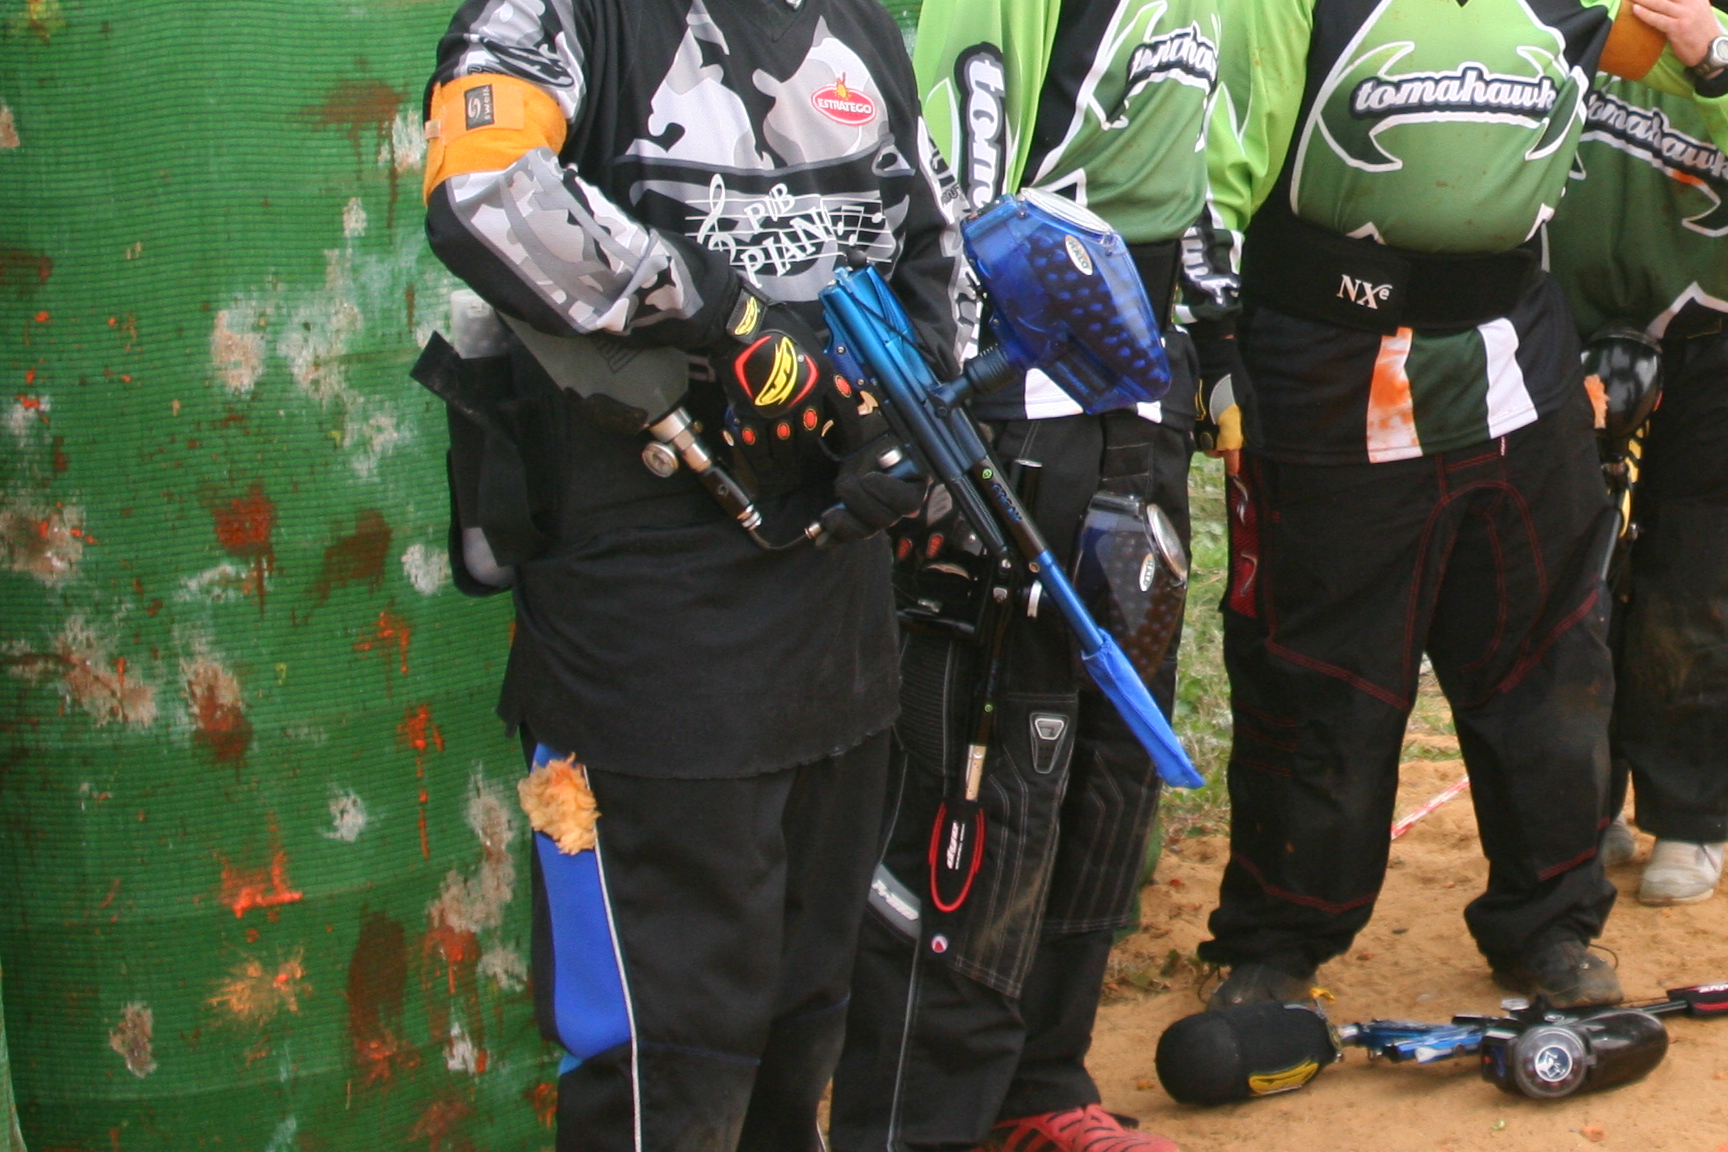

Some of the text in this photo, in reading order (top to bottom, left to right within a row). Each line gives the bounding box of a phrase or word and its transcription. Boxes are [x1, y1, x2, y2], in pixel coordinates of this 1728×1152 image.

[817, 97, 873, 114] ESTRATEGO
[1354, 69, 1558, 112] tomahawk
[1067, 239, 1089, 269] HALO
